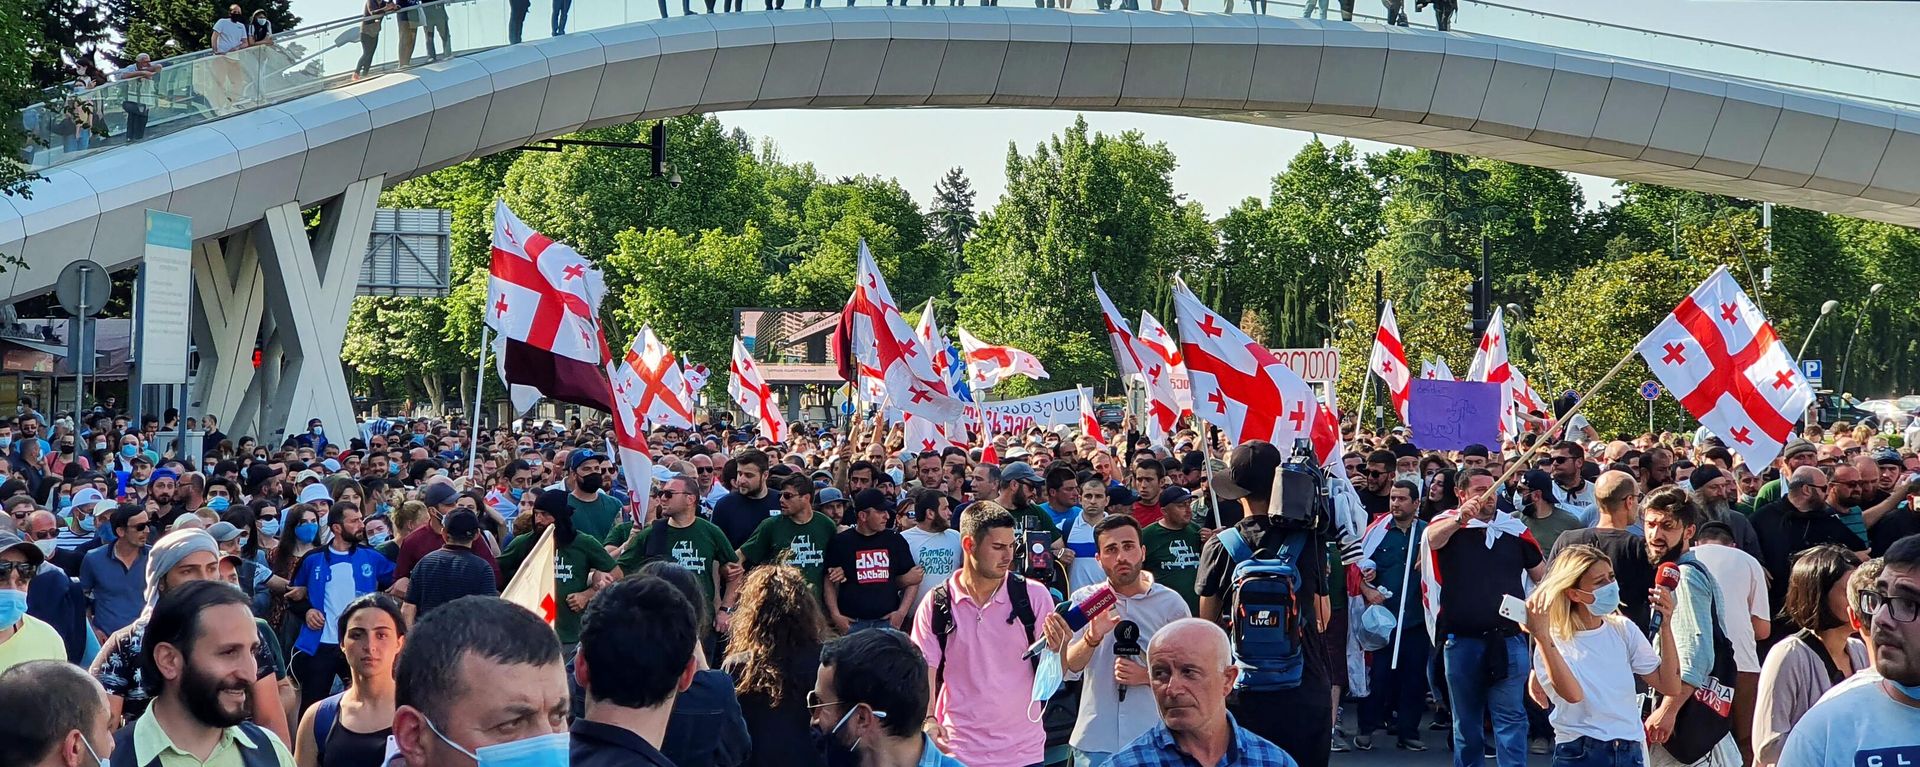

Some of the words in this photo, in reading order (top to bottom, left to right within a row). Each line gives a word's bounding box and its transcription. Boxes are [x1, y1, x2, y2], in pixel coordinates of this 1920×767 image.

[1806, 361, 1818, 377] P
[856, 551, 890, 569] ძალა
[1695, 688, 1721, 712] EWS
